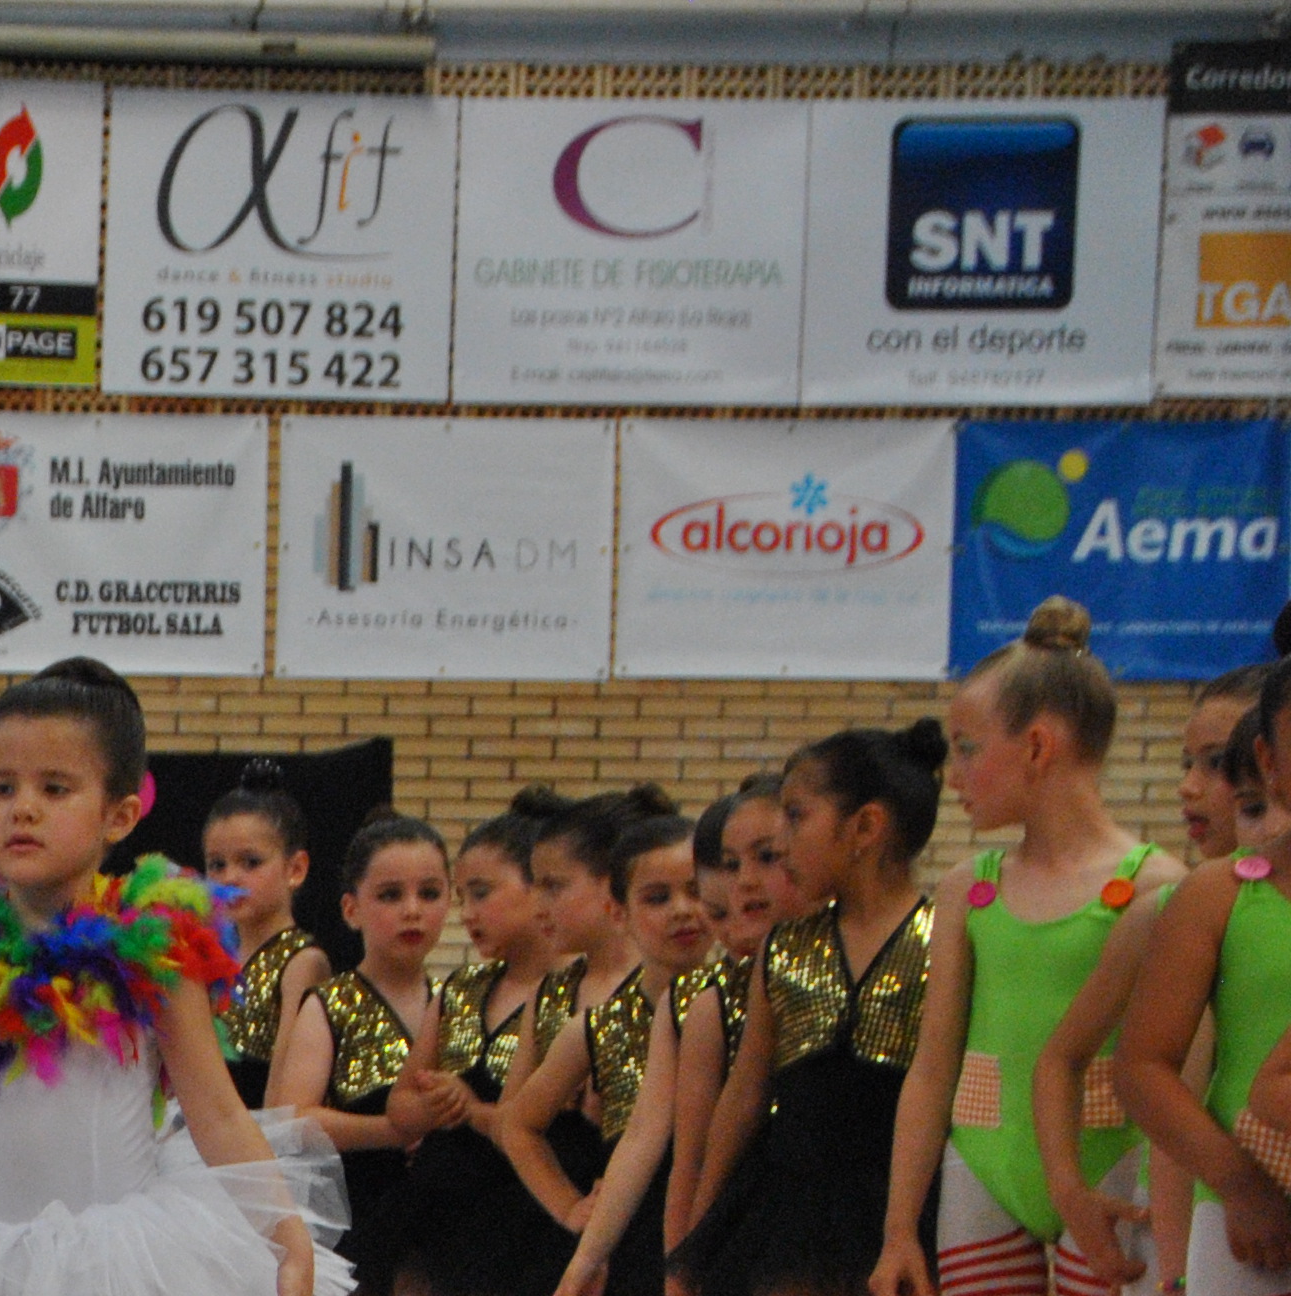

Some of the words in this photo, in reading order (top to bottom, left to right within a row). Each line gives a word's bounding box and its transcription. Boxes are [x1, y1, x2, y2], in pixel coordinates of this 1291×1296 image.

[1185, 62, 1291, 91] Corredo
[908, 208, 1057, 273] SNT
[474, 258, 584, 287] GABINETE
[592, 259, 621, 288] DE
[636, 258, 784, 289] FISIOTERAPIA
[9, 285, 41, 312] 77
[142, 296, 221, 334] 619
[234, 299, 313, 336] 507
[325, 301, 403, 339] 824
[866, 325, 922, 350] con
[930, 325, 960, 351] el
[968, 324, 1087, 357] deporte
[140, 346, 219, 384] 657
[232, 348, 311, 386] 315
[323, 351, 402, 389] 422
[49, 457, 90, 485] M.I.
[98, 458, 236, 489] Ayuntamiento
[49, 494, 74, 519] de
[81, 493, 146, 520] Alfaro
[681, 501, 891, 568] alcorioja
[388, 536, 497, 570] INSA
[516, 537, 579, 571] DM
[99, 580, 243, 605] GRACCURRIS
[165, 613, 224, 637] SALA
